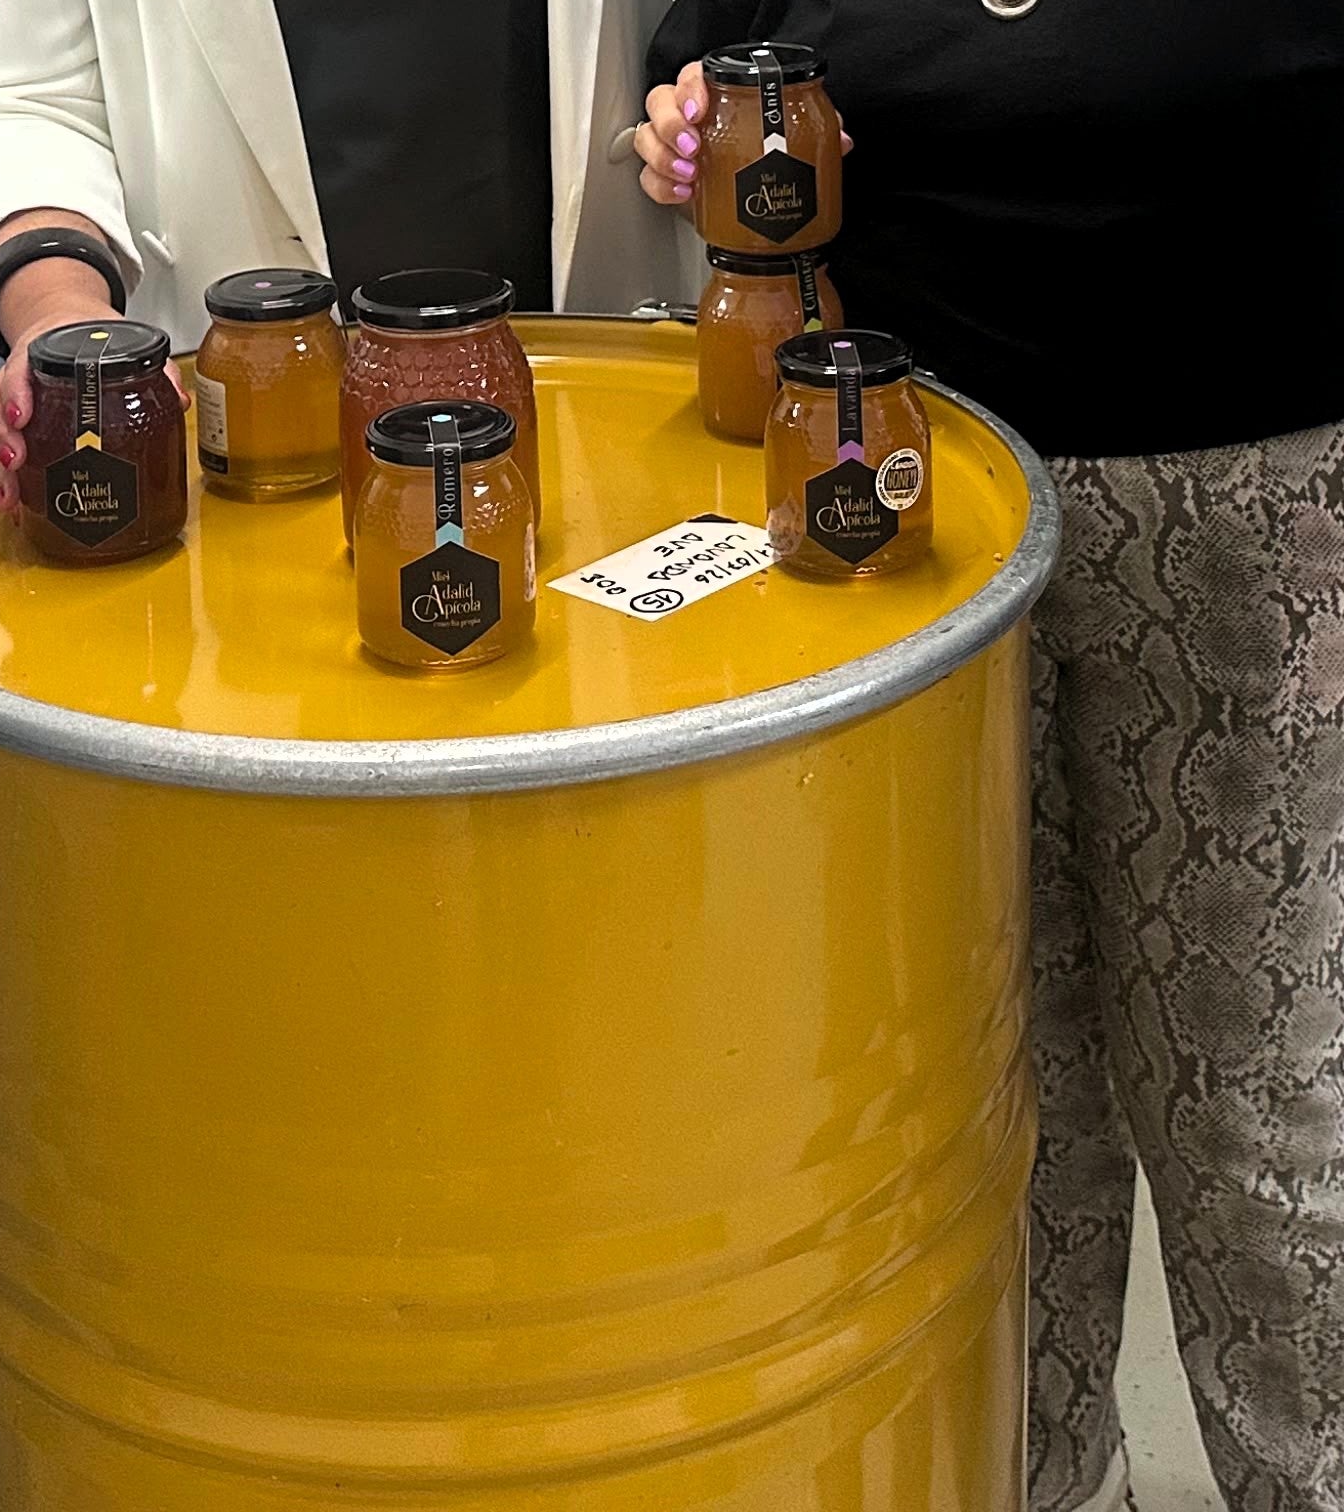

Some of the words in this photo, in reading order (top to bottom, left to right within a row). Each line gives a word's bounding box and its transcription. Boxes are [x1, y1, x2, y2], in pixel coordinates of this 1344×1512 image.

[841, 368, 857, 431] Lavanda
[437, 448, 456, 521] Romero
[642, 592, 673, 609] 15
